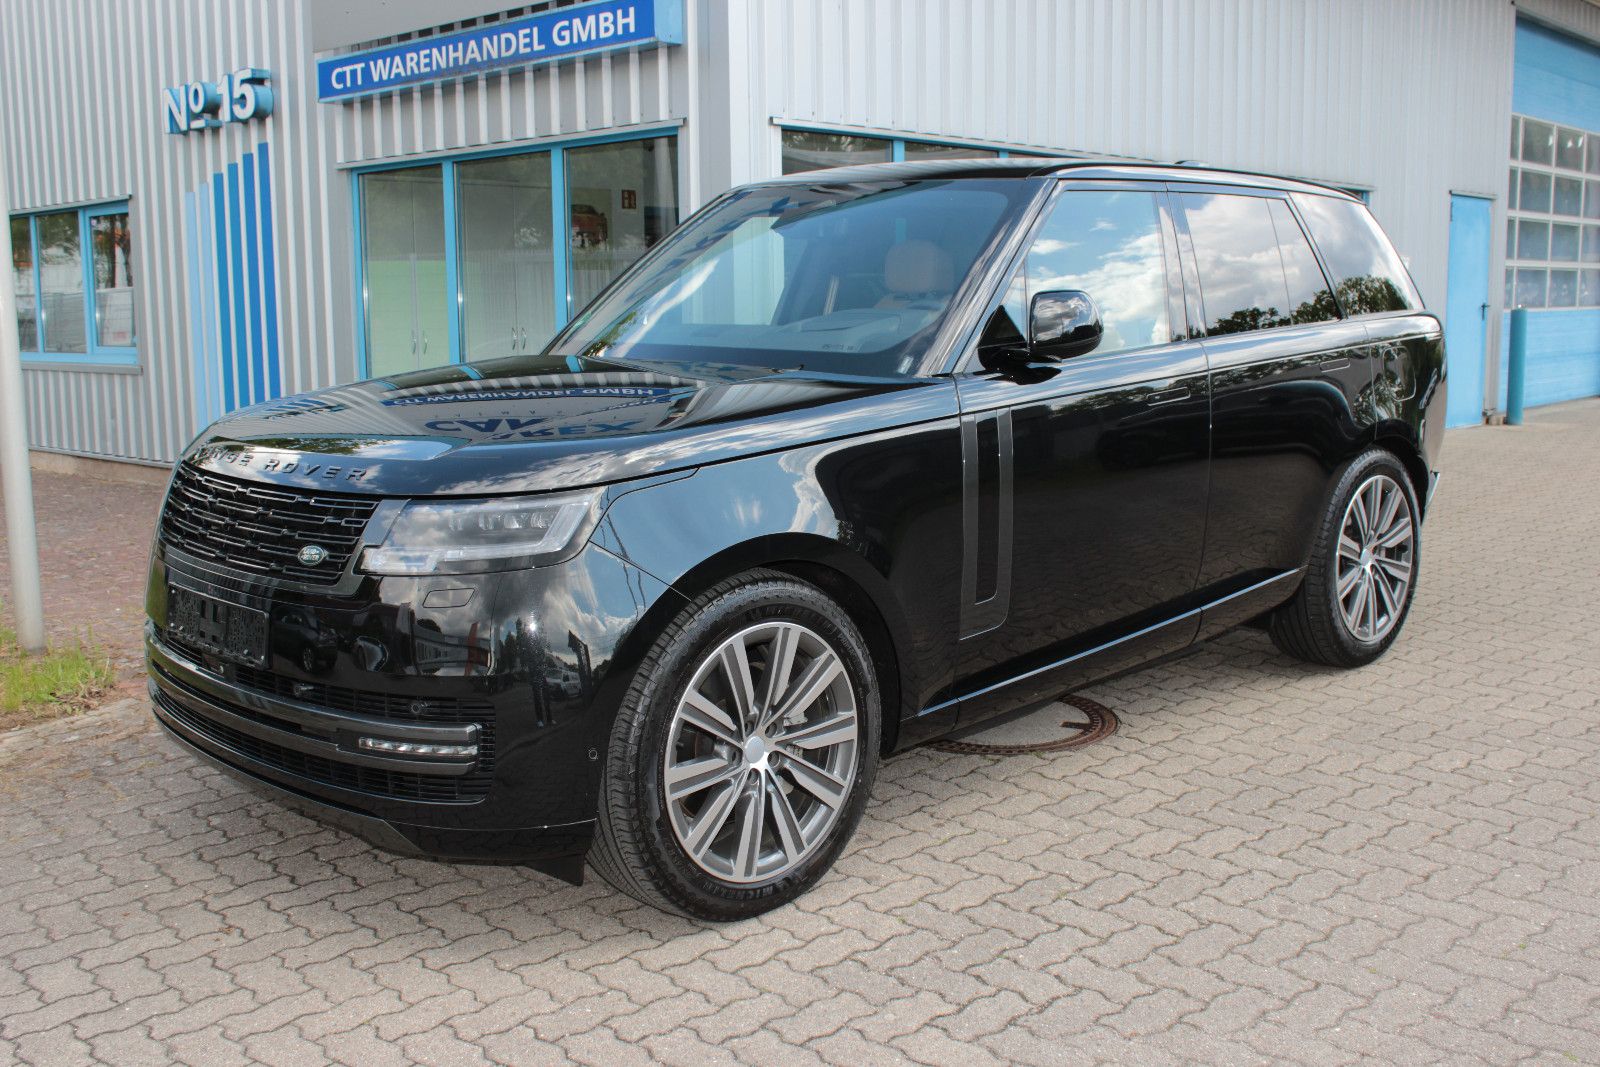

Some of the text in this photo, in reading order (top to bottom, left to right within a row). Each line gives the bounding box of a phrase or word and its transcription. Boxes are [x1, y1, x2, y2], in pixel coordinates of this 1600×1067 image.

[330, 6, 636, 90] CTT WARENHANDEL GMBH
[216, 68, 259, 122] 15
[264, 459, 367, 481] ROVER
